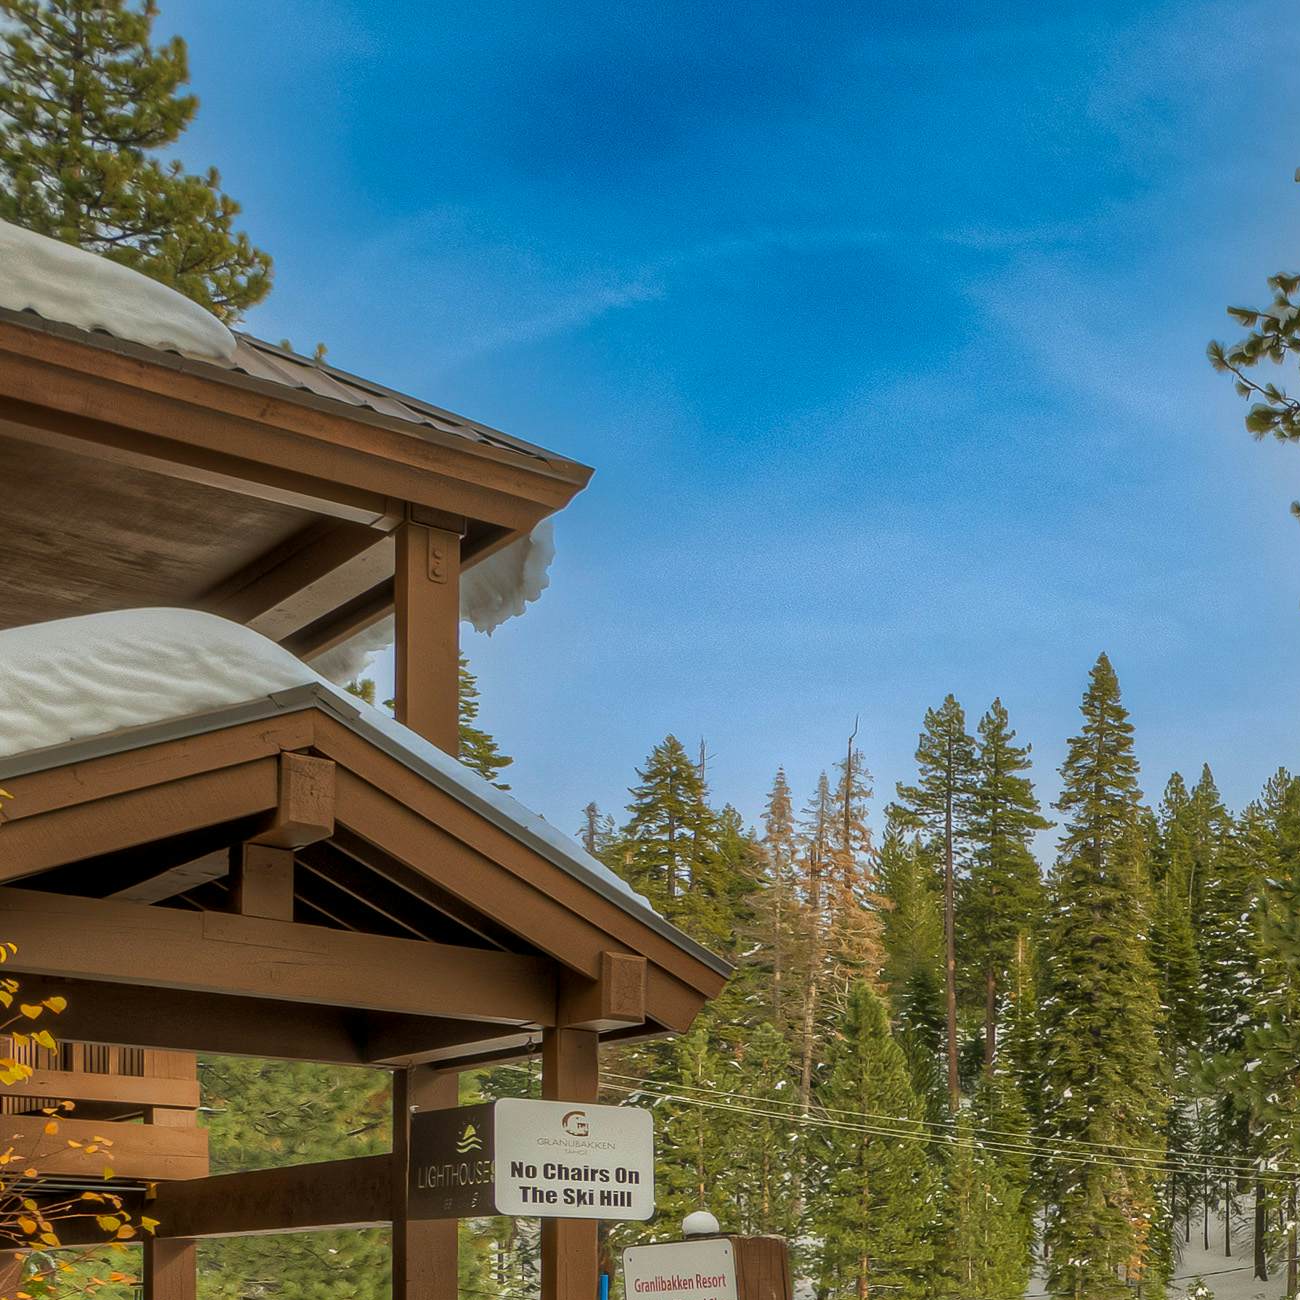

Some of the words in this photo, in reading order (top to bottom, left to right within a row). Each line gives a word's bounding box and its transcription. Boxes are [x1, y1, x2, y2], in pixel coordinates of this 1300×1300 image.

[511, 1161, 537, 1179] No
[543, 1163, 610, 1184] Chairs
[615, 1167, 640, 1185] On
[519, 1186, 558, 1204] The
[563, 1187, 594, 1207] Ski
[600, 1190, 632, 1207] Hill
[634, 1275, 694, 1293] Granlibakken
[696, 1273, 727, 1289] Resort
